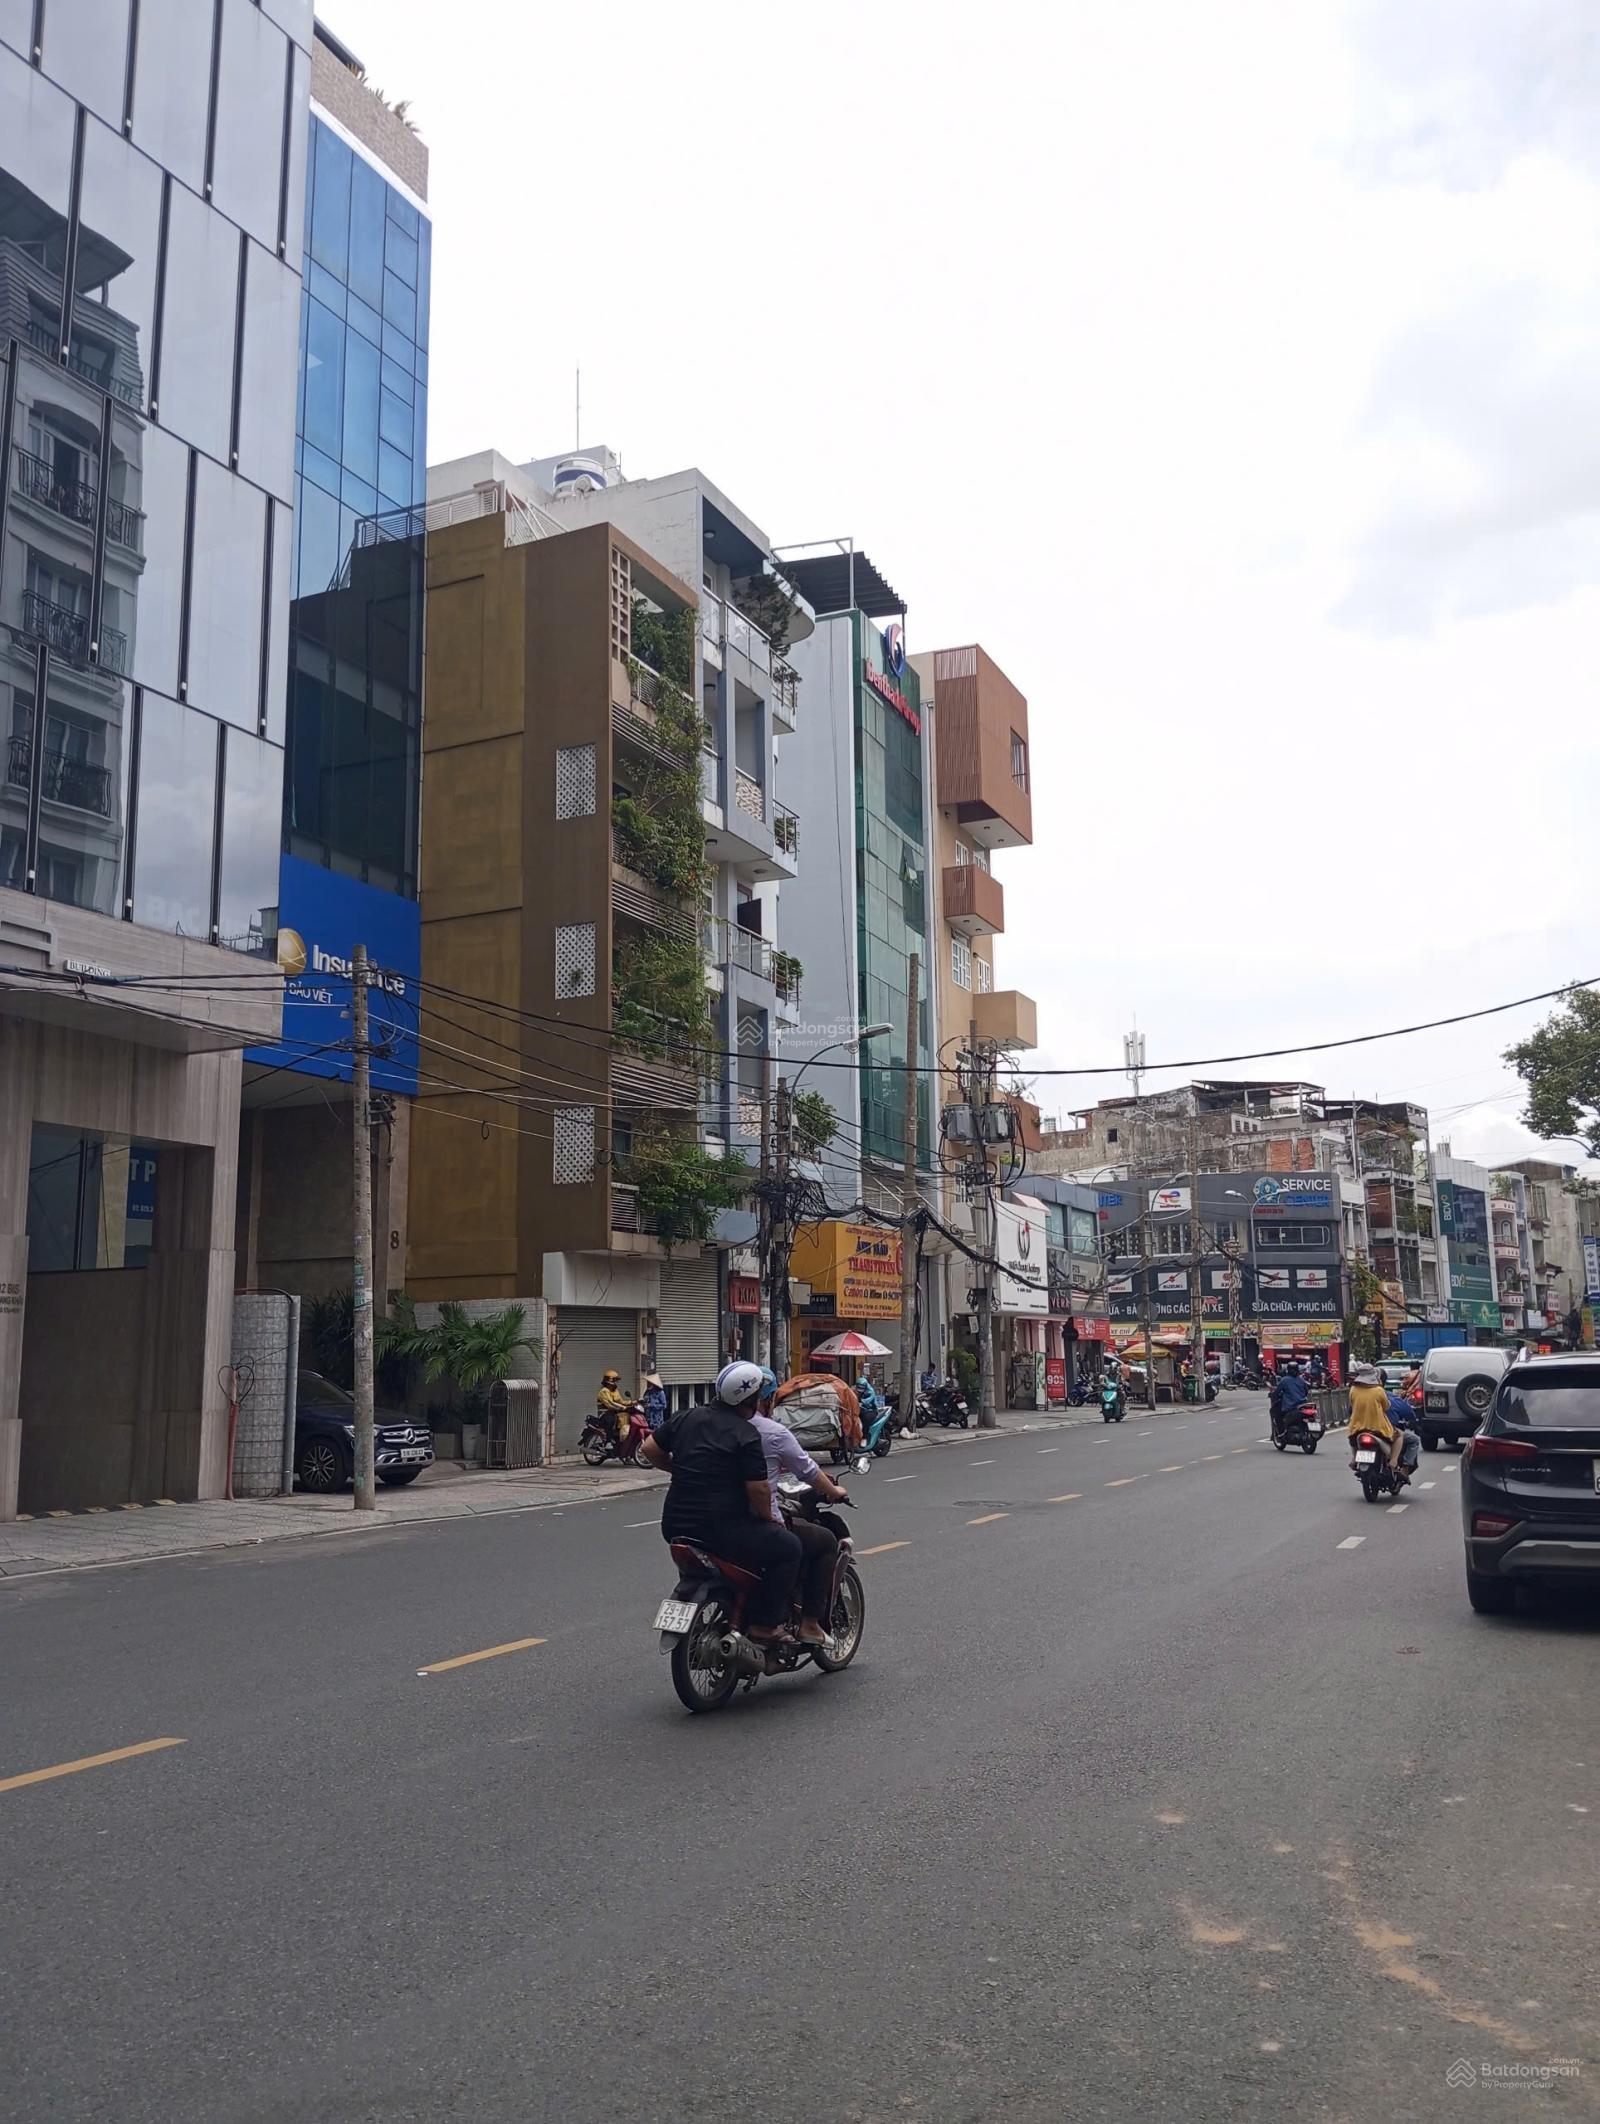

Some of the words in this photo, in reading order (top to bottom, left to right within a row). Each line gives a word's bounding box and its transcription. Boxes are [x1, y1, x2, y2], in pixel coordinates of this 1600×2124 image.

[313, 945, 405, 995] Insuance
[1282, 1179, 1331, 1191] SERVICE
[391, 1231, 399, 1249] 8
[1173, 1302, 1190, 1314] CÁC
[1212, 1303, 1224, 1313] XE
[1270, 1300, 1293, 1311] CHỮA
[1297, 1302, 1320, 1314] PHỤC
[1321, 1298, 1336, 1311] HỒI
